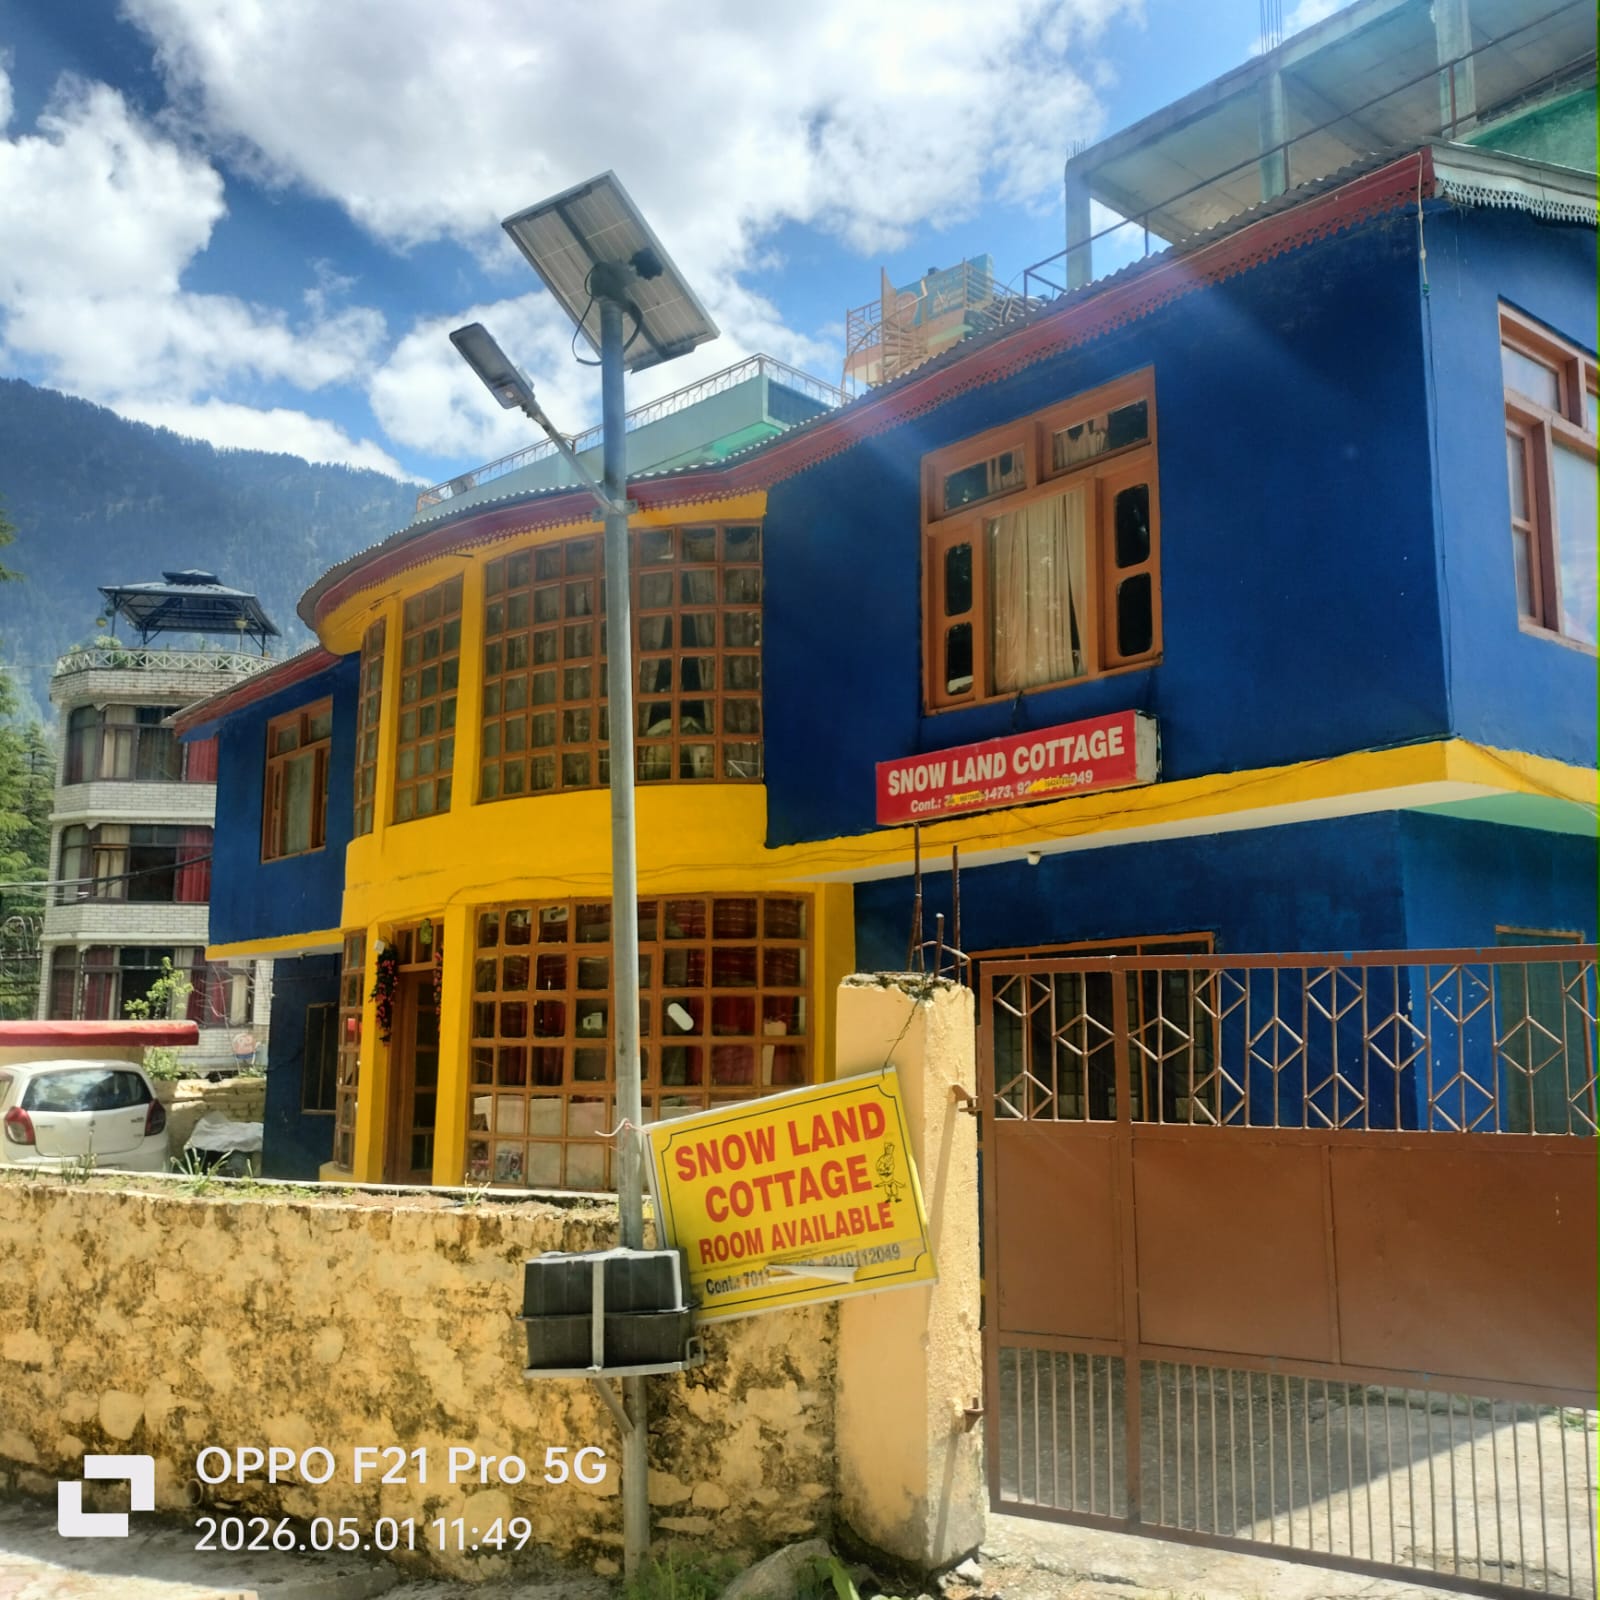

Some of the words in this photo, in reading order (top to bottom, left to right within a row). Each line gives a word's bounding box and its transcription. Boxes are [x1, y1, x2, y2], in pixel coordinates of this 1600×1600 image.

[888, 761, 947, 796] SNOW
[952, 751, 1008, 786] LAND
[1012, 726, 1125, 775] COTTAGE
[675, 1125, 775, 1182] SNOW
[787, 1102, 886, 1156] LAND
[705, 1154, 873, 1223] COTTAGE
[699, 1227, 764, 1265] ROOM
[772, 1202, 894, 1249] AVAILABLE
